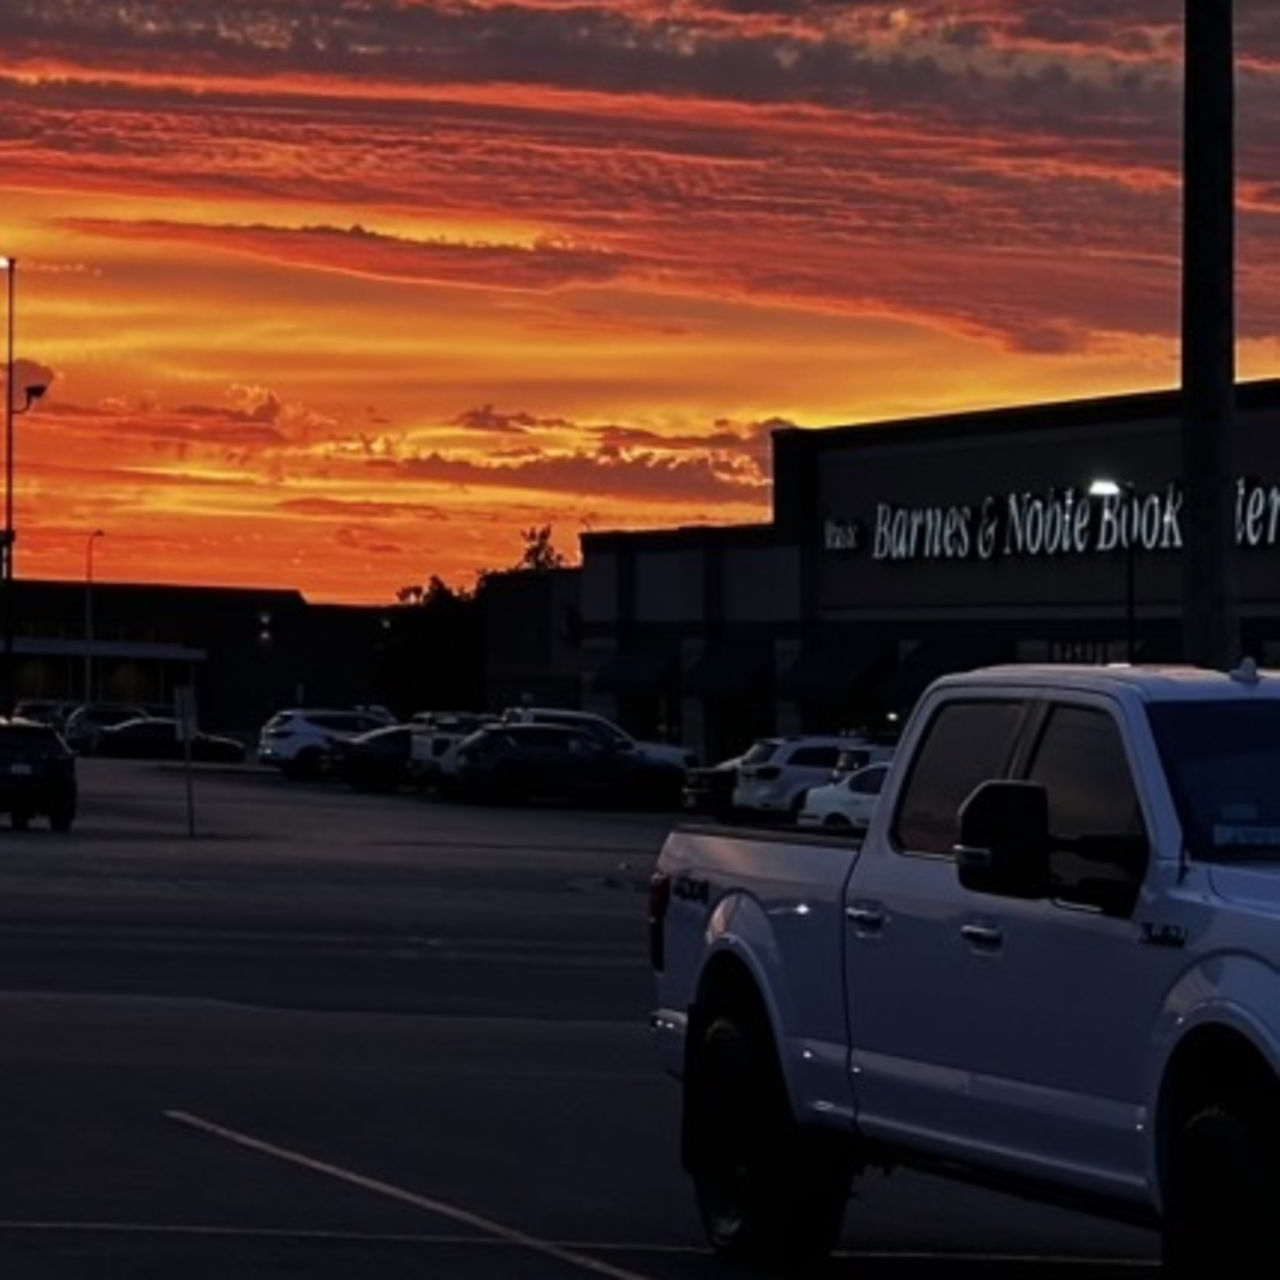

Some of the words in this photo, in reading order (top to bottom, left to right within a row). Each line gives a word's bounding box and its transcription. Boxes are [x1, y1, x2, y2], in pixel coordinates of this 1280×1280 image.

[871, 501, 972, 559] Barnes
[976, 494, 999, 559] &
[1002, 489, 1090, 555] Noble
